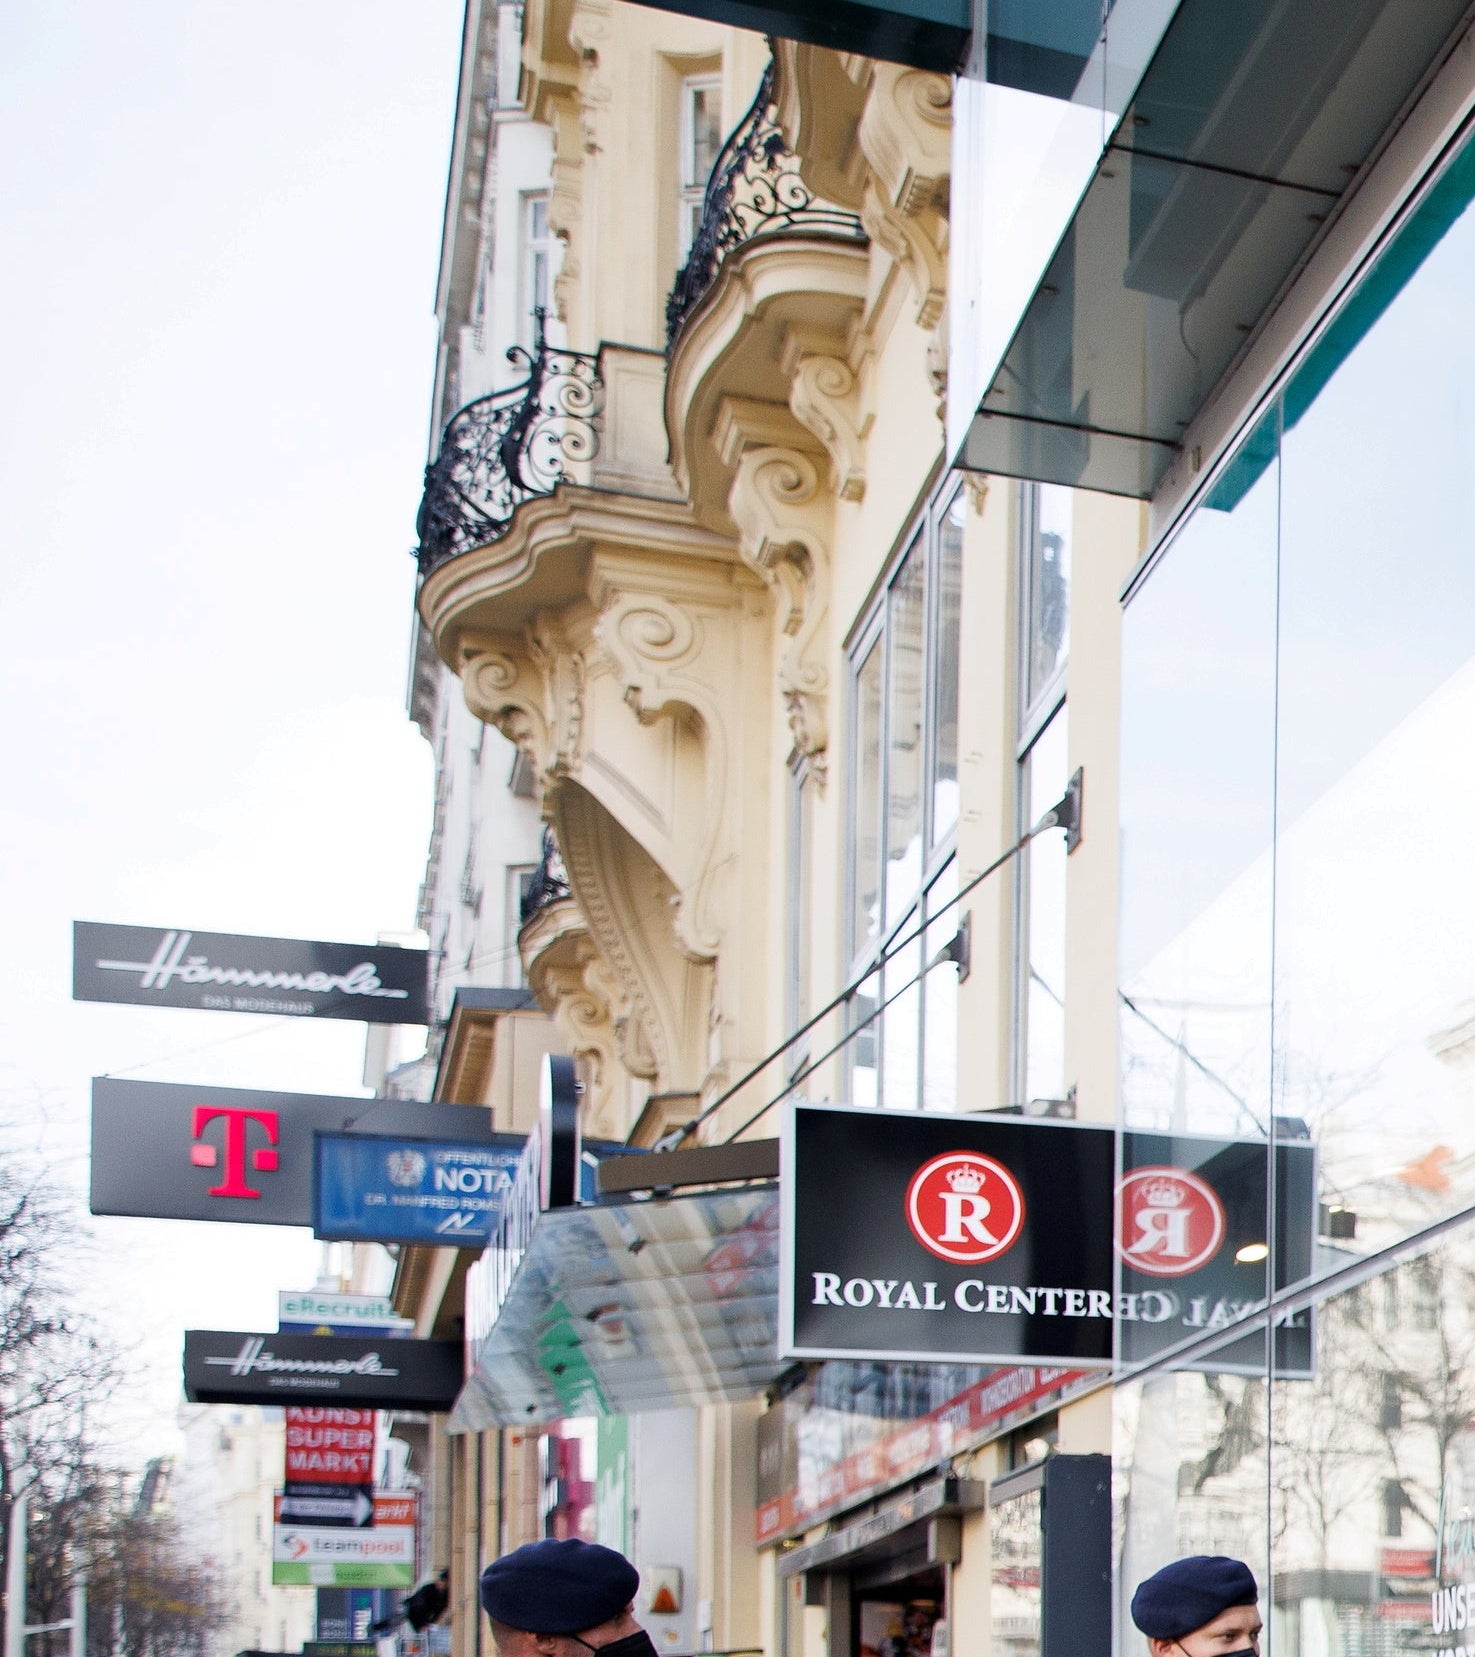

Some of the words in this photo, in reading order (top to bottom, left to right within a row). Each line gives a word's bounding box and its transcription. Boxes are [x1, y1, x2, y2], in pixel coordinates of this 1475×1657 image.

[96, 930, 409, 998] Hämmerle
[434, 1166, 514, 1193] NOTA
[938, 1192, 1000, 1246] R
[811, 1271, 947, 1311] ROYAL
[954, 1279, 1115, 1318] CENTER
[203, 1336, 399, 1378] Hämmerle
[286, 1426, 374, 1449] SUPER
[287, 1451, 371, 1472] MARKT
